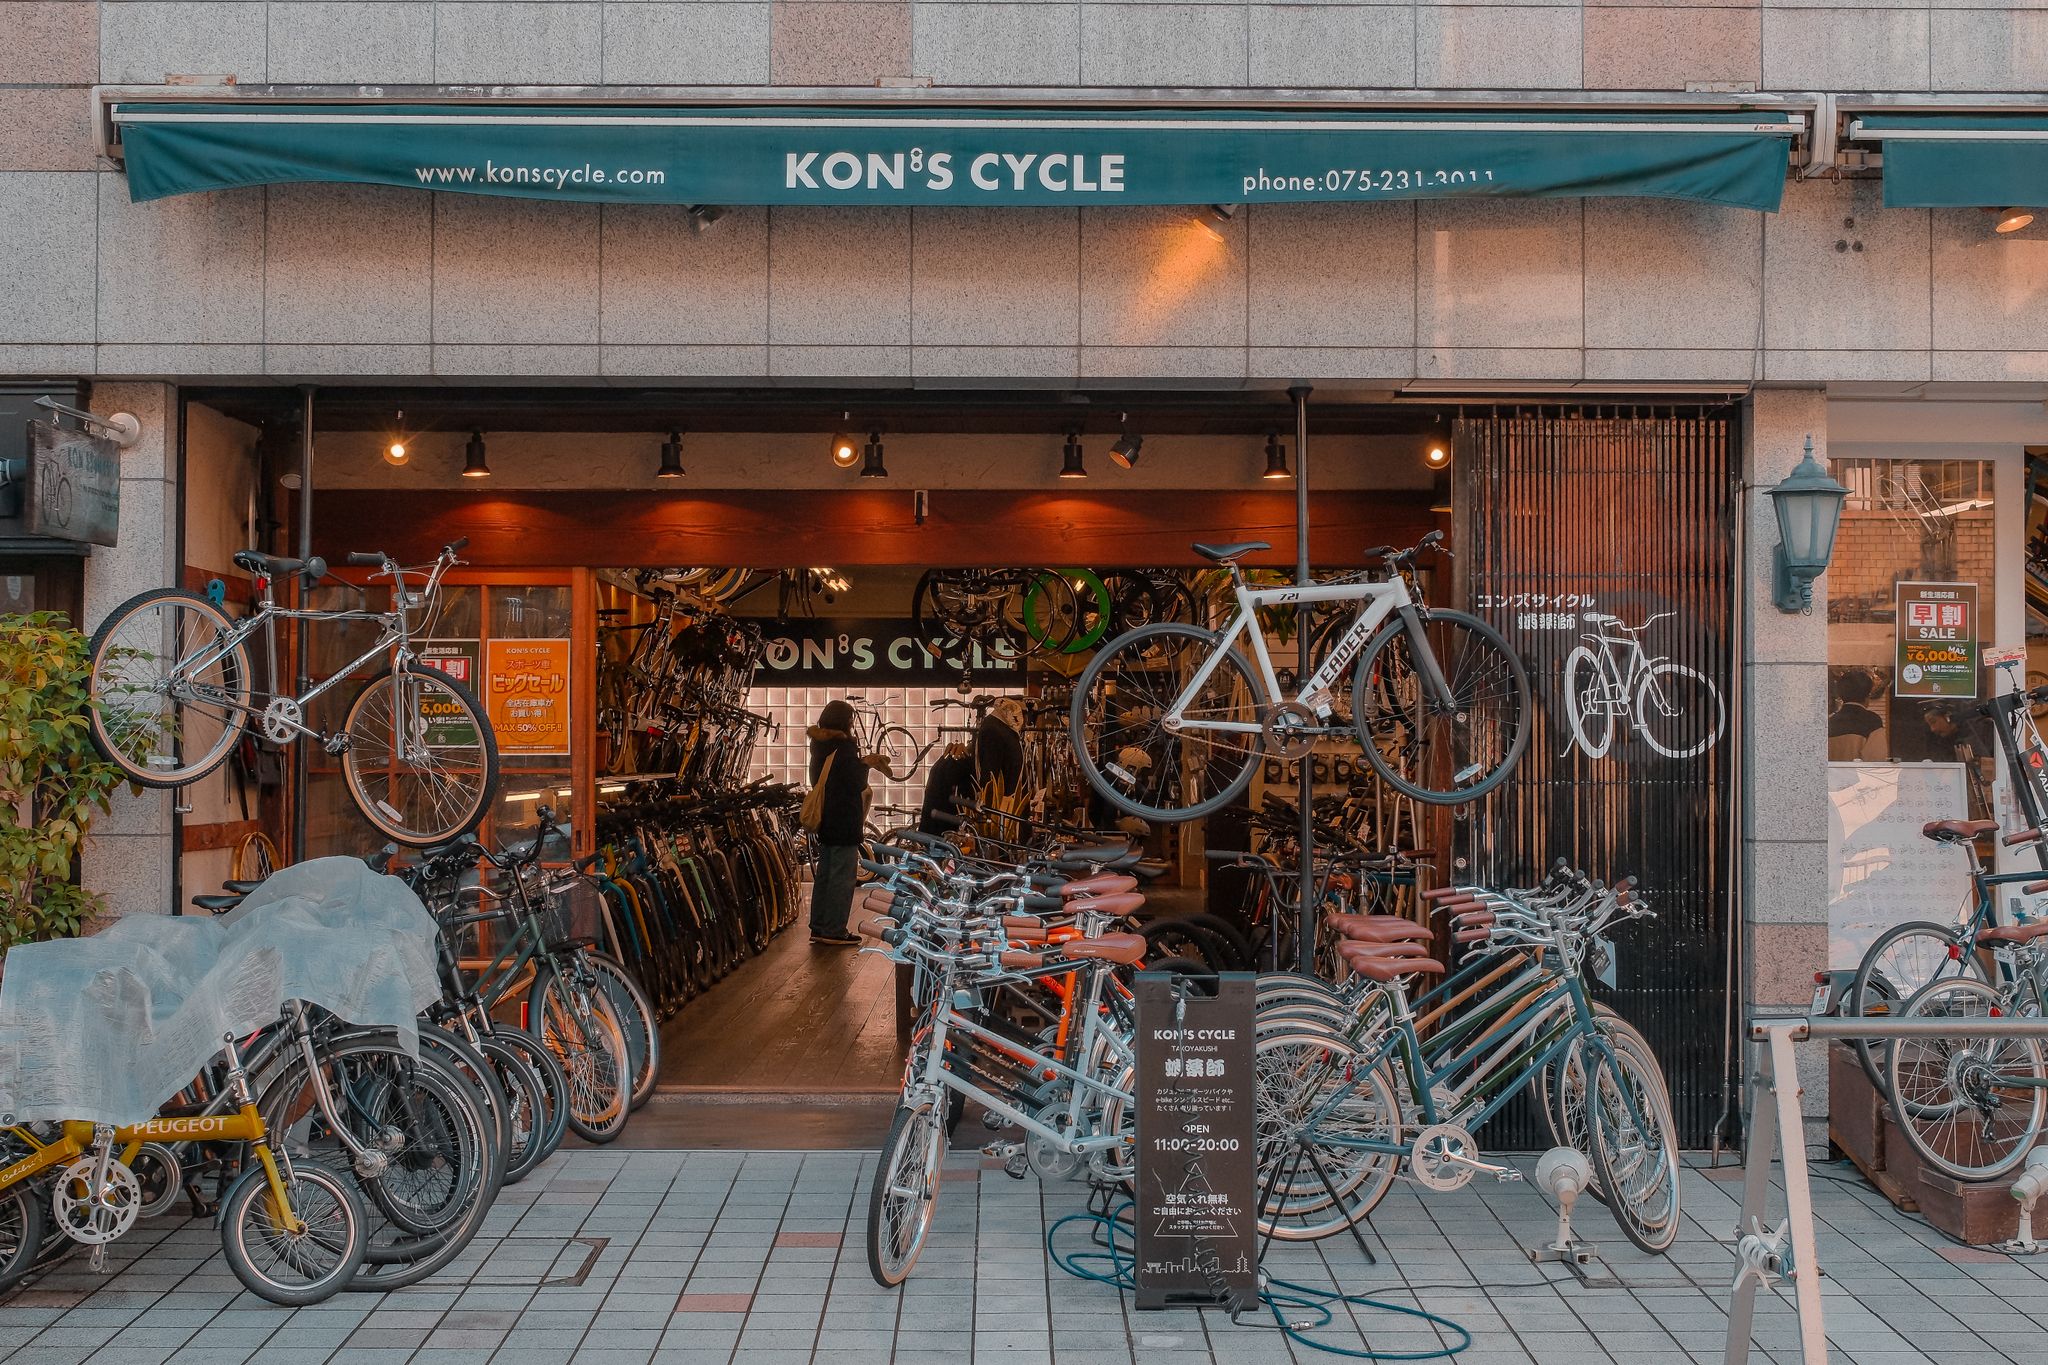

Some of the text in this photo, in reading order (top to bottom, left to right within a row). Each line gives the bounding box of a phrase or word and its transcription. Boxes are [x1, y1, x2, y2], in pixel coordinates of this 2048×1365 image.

[415, 159, 665, 189] www.konscycle.com
[786, 148, 1125, 191] KON'S CYCLE
[1280, 592, 1299, 600] 721
[1478, 592, 1595, 608] コンズサイクル
[1913, 604, 1962, 626] 早割
[1920, 628, 1956, 639] SALE
[754, 633, 876, 670] ON'S
[1948, 645, 1966, 656] MAX
[506, 659, 552, 670] スポーツ車
[491, 673, 564, 693] ビッグセール
[494, 723, 516, 732] MAX
[517, 723, 537, 732] 50%
[1197, 1030, 1235, 1040] CYCLE
[133, 1117, 228, 1134] PEUGEOT
[1182, 1124, 1210, 1133] OPEN
[1154, 1138, 1239, 1151] 11:00-20:00
